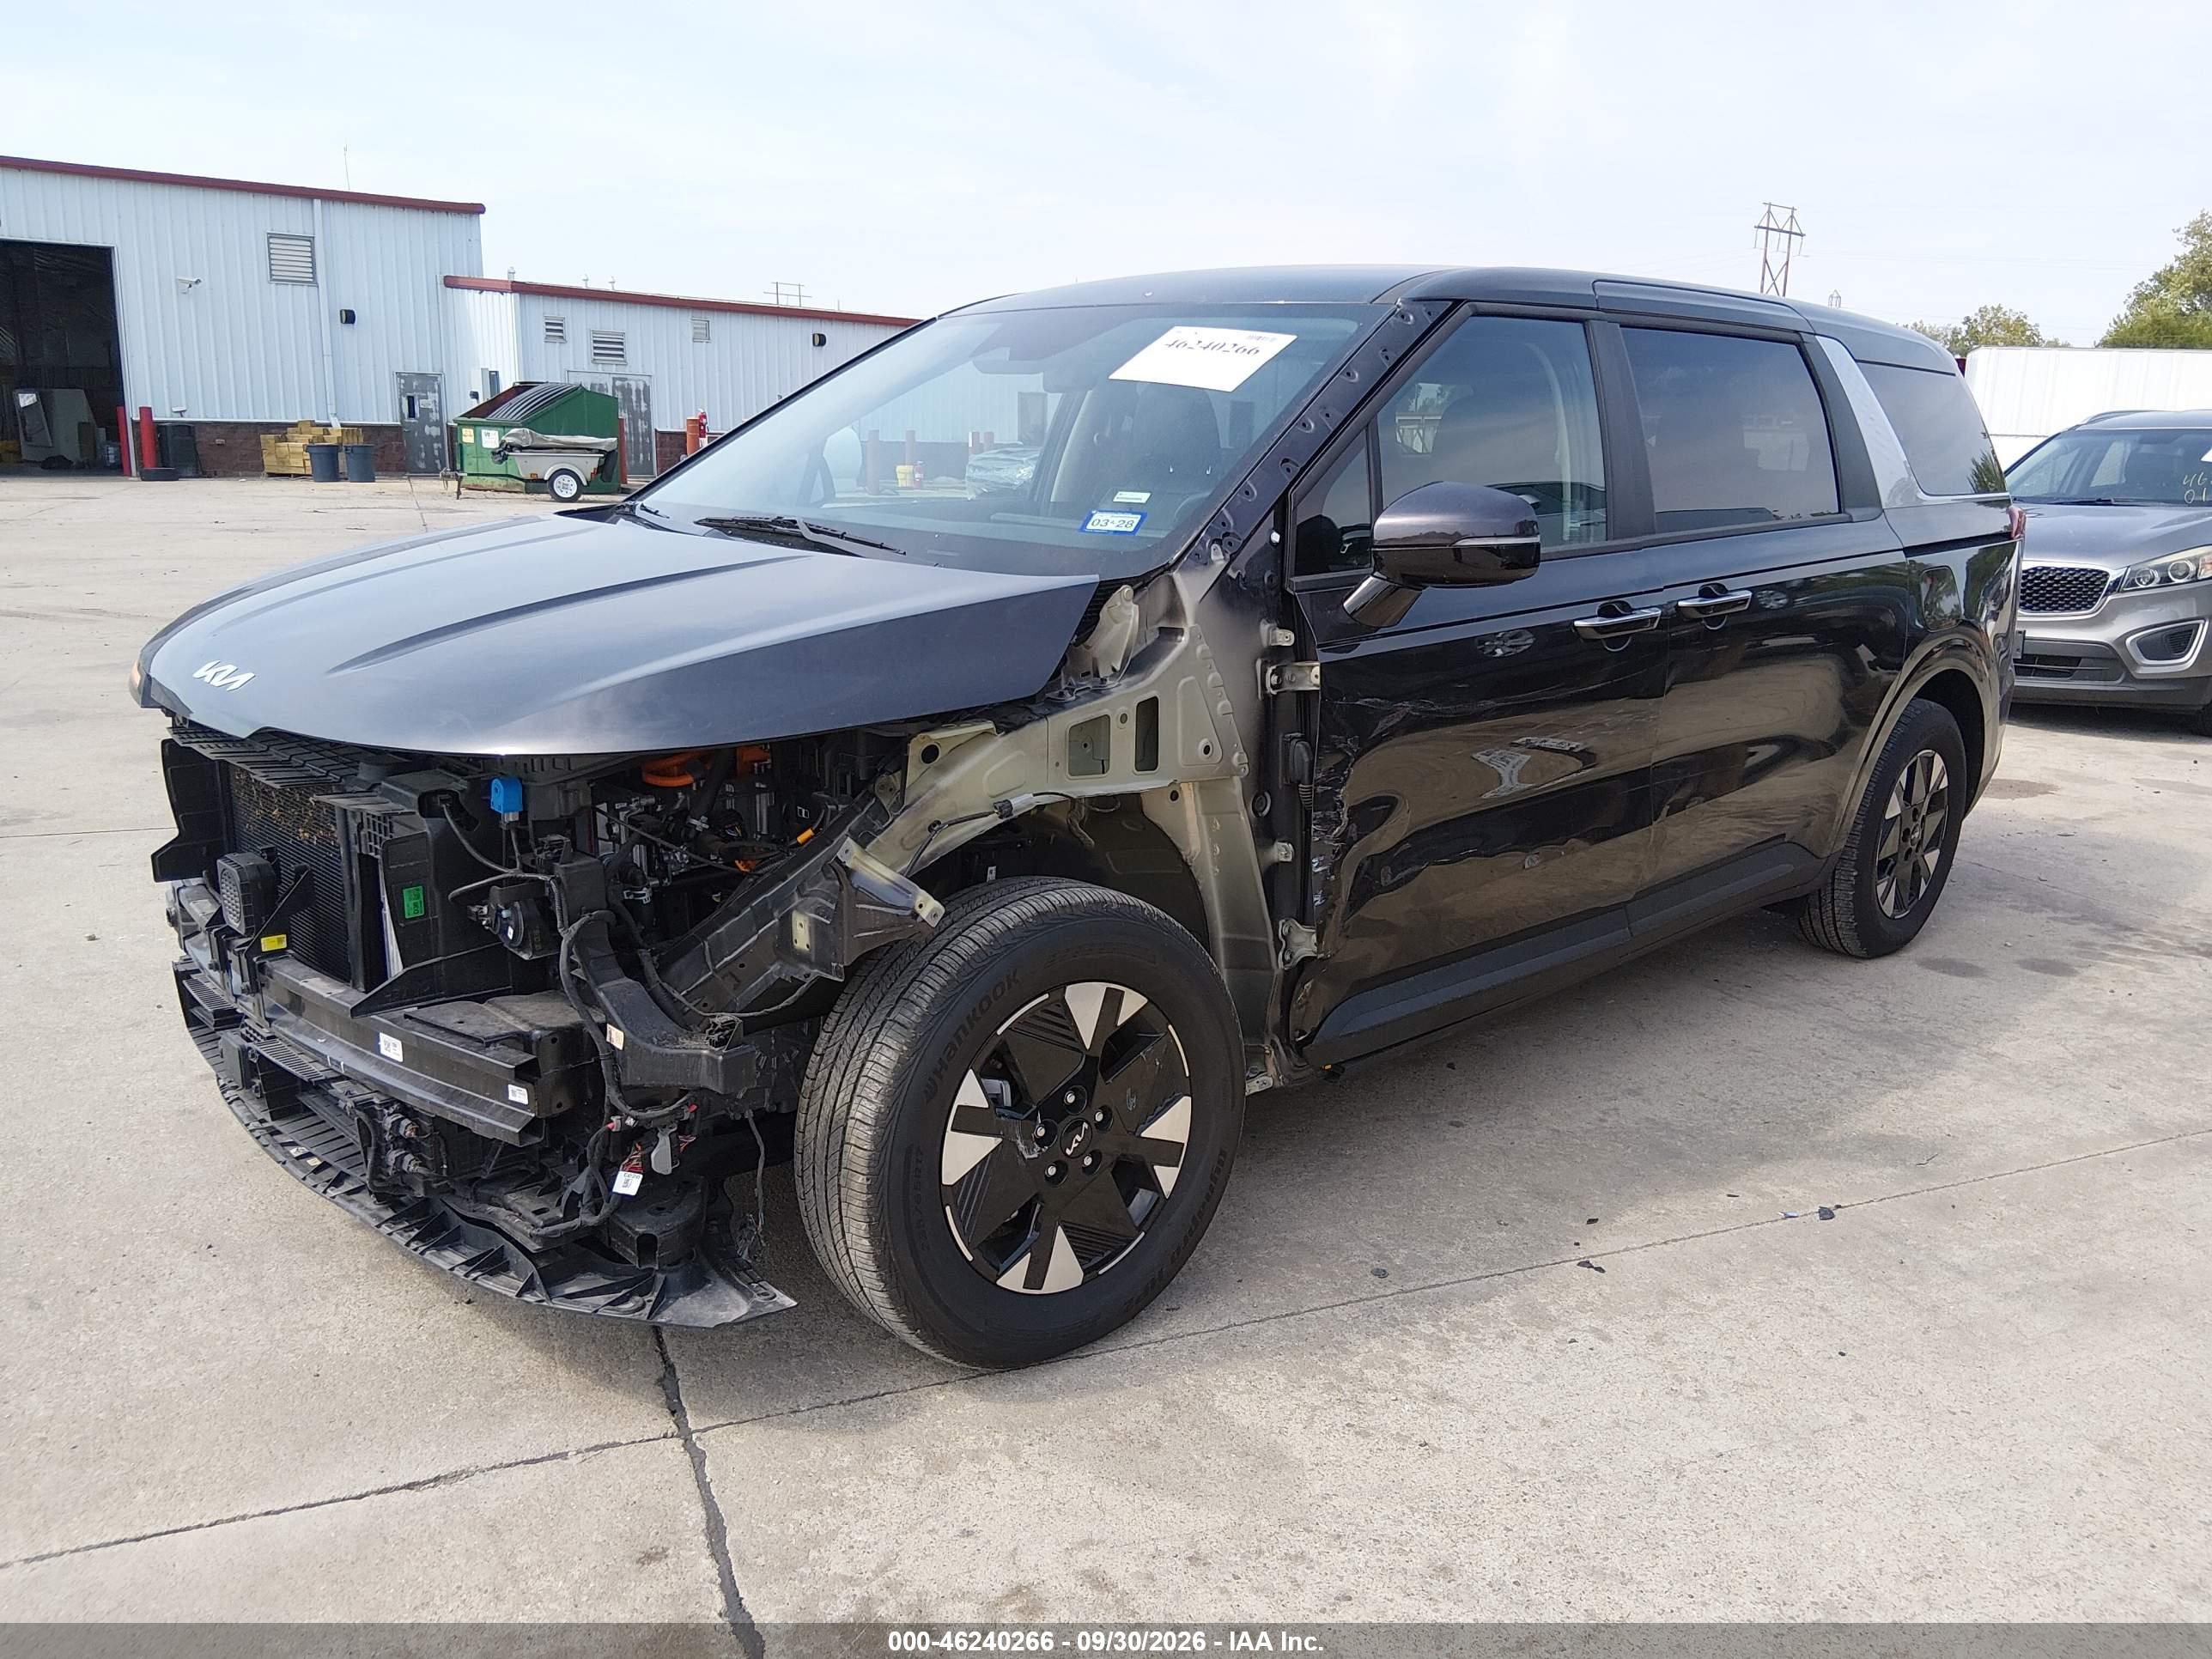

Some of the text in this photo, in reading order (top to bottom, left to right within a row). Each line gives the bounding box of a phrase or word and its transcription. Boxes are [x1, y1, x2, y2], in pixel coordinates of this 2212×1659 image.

[1164, 339, 1260, 355] 46240266
[2183, 471, 2212, 487] 46
[192, 659, 256, 691] KIA
